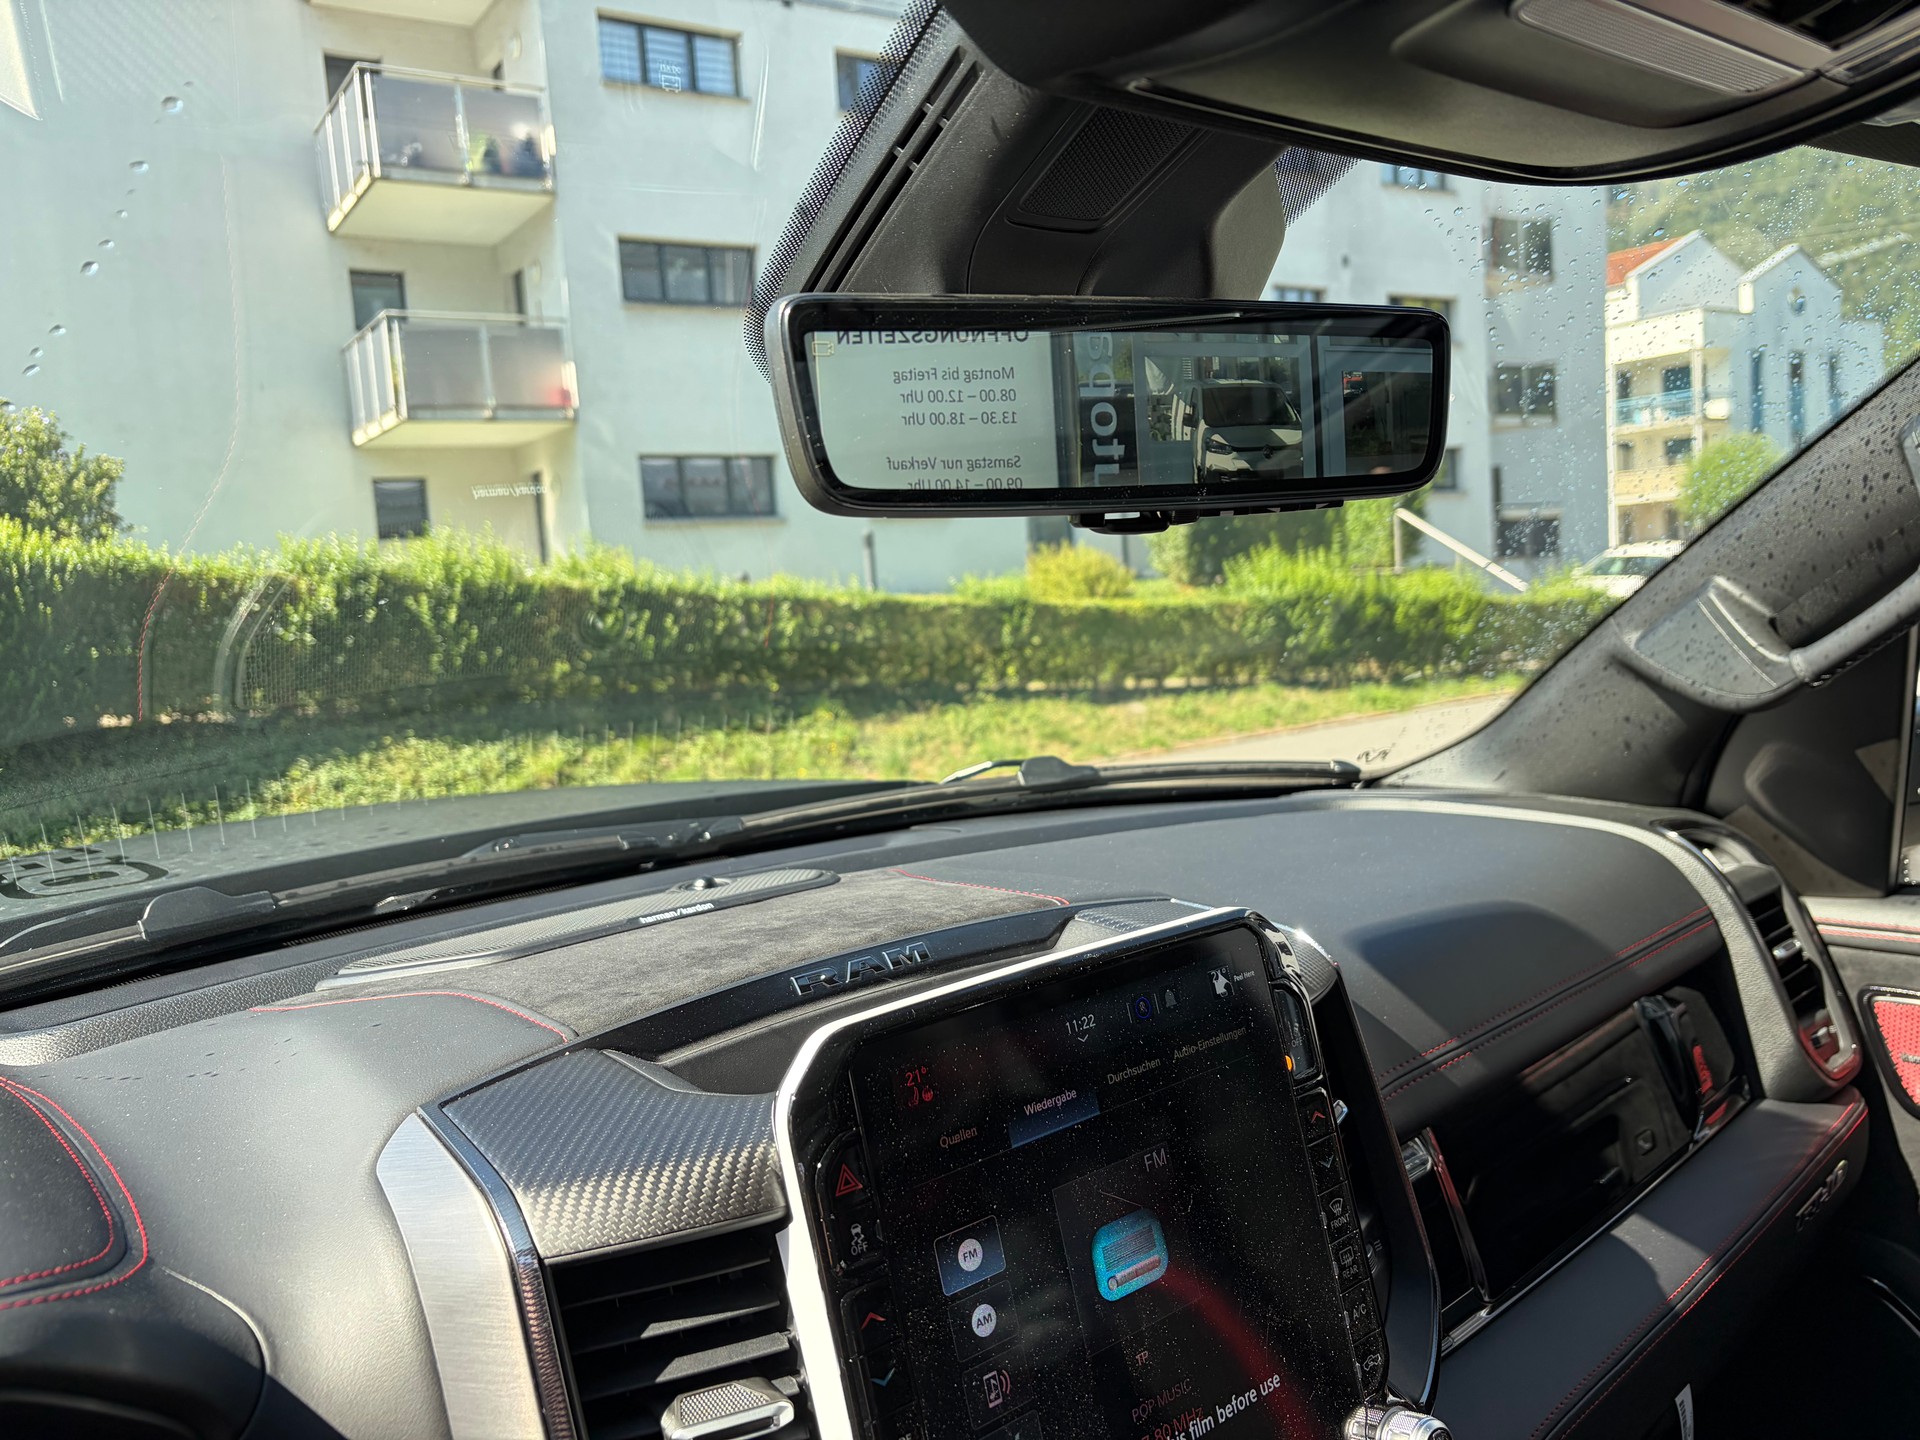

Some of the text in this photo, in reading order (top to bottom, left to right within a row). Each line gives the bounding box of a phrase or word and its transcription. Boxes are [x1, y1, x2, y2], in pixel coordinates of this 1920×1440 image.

[639, 902, 715, 924] harman/kardon
[790, 941, 933, 996] RAM
[1233, 970, 1255, 982] Peel Here
[1065, 1014, 1096, 1035] 11:22
[1173, 1026, 1247, 1060] Audio-Einstellungen
[1107, 1057, 1161, 1085] Durchsuchen
[1023, 1088, 1078, 1116] Wiedergabe
[939, 1126, 978, 1149] Quellen
[1143, 1148, 1168, 1172] FM
[1330, 1213, 1350, 1230] FRONT
[850, 1242, 869, 1256] OFF
[962, 1250, 979, 1262] FM
[1342, 1265, 1359, 1279] REAR
[976, 1313, 993, 1329] AM
[1353, 1303, 1367, 1321] A/C
[1156, 1379, 1192, 1408] MUSIC
[1188, 1415, 1215, 1440] film
[1215, 1387, 1258, 1424] before
[1260, 1373, 1282, 1397] use
